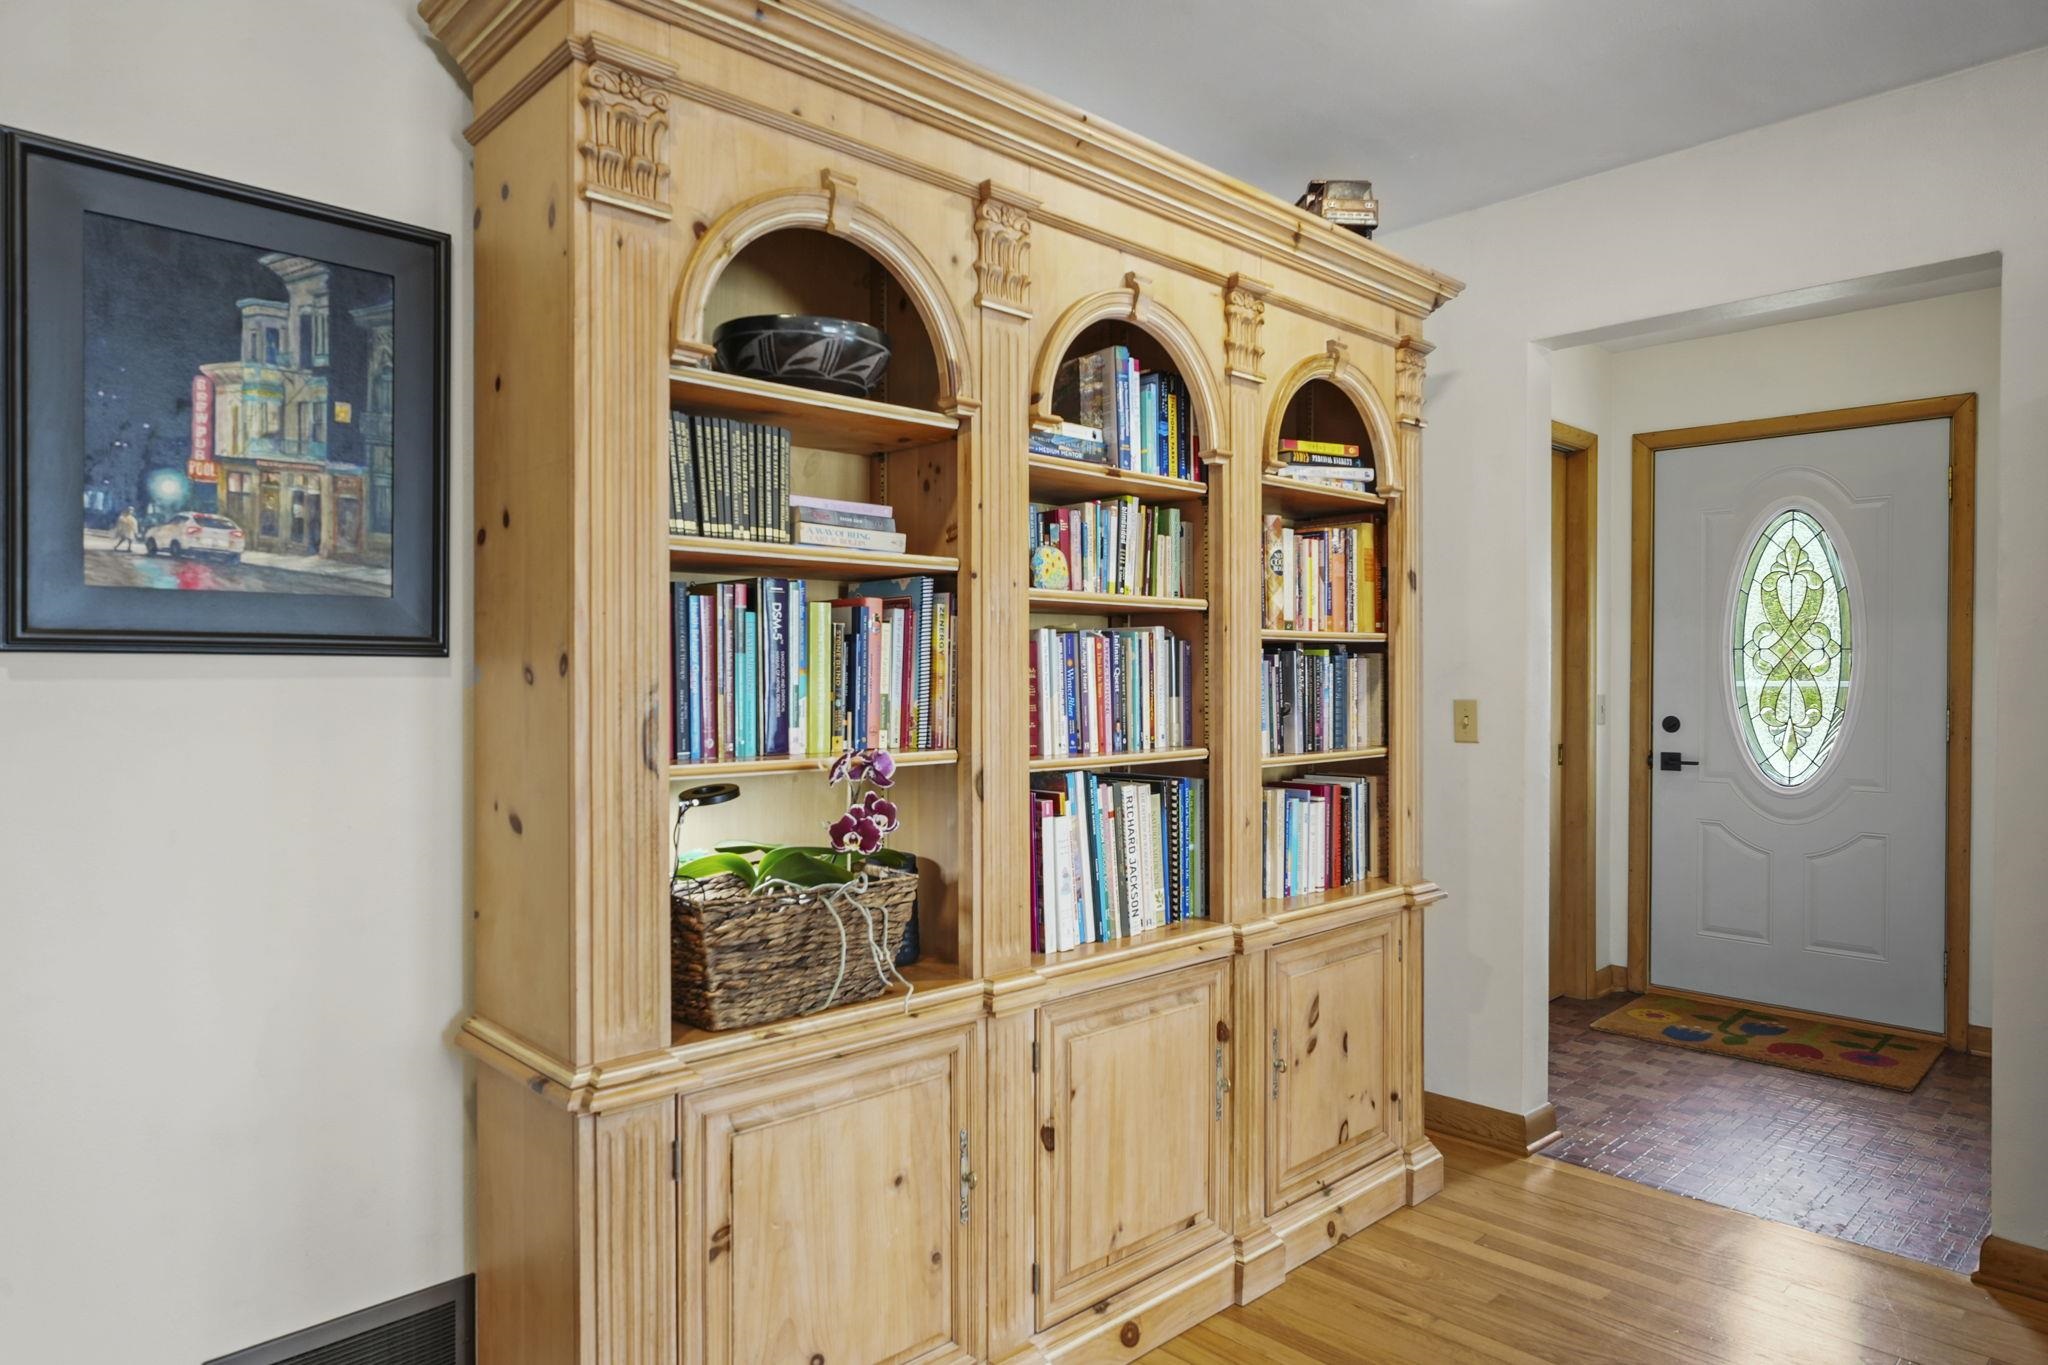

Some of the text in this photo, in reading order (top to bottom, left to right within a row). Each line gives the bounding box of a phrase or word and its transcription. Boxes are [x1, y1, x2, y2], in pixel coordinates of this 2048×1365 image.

[188, 460, 216, 477] POOL
[847, 531, 870, 540] BEING
[772, 602, 783, 641] DSM-5
[1126, 795, 1140, 918] RICHARD JACKSON
